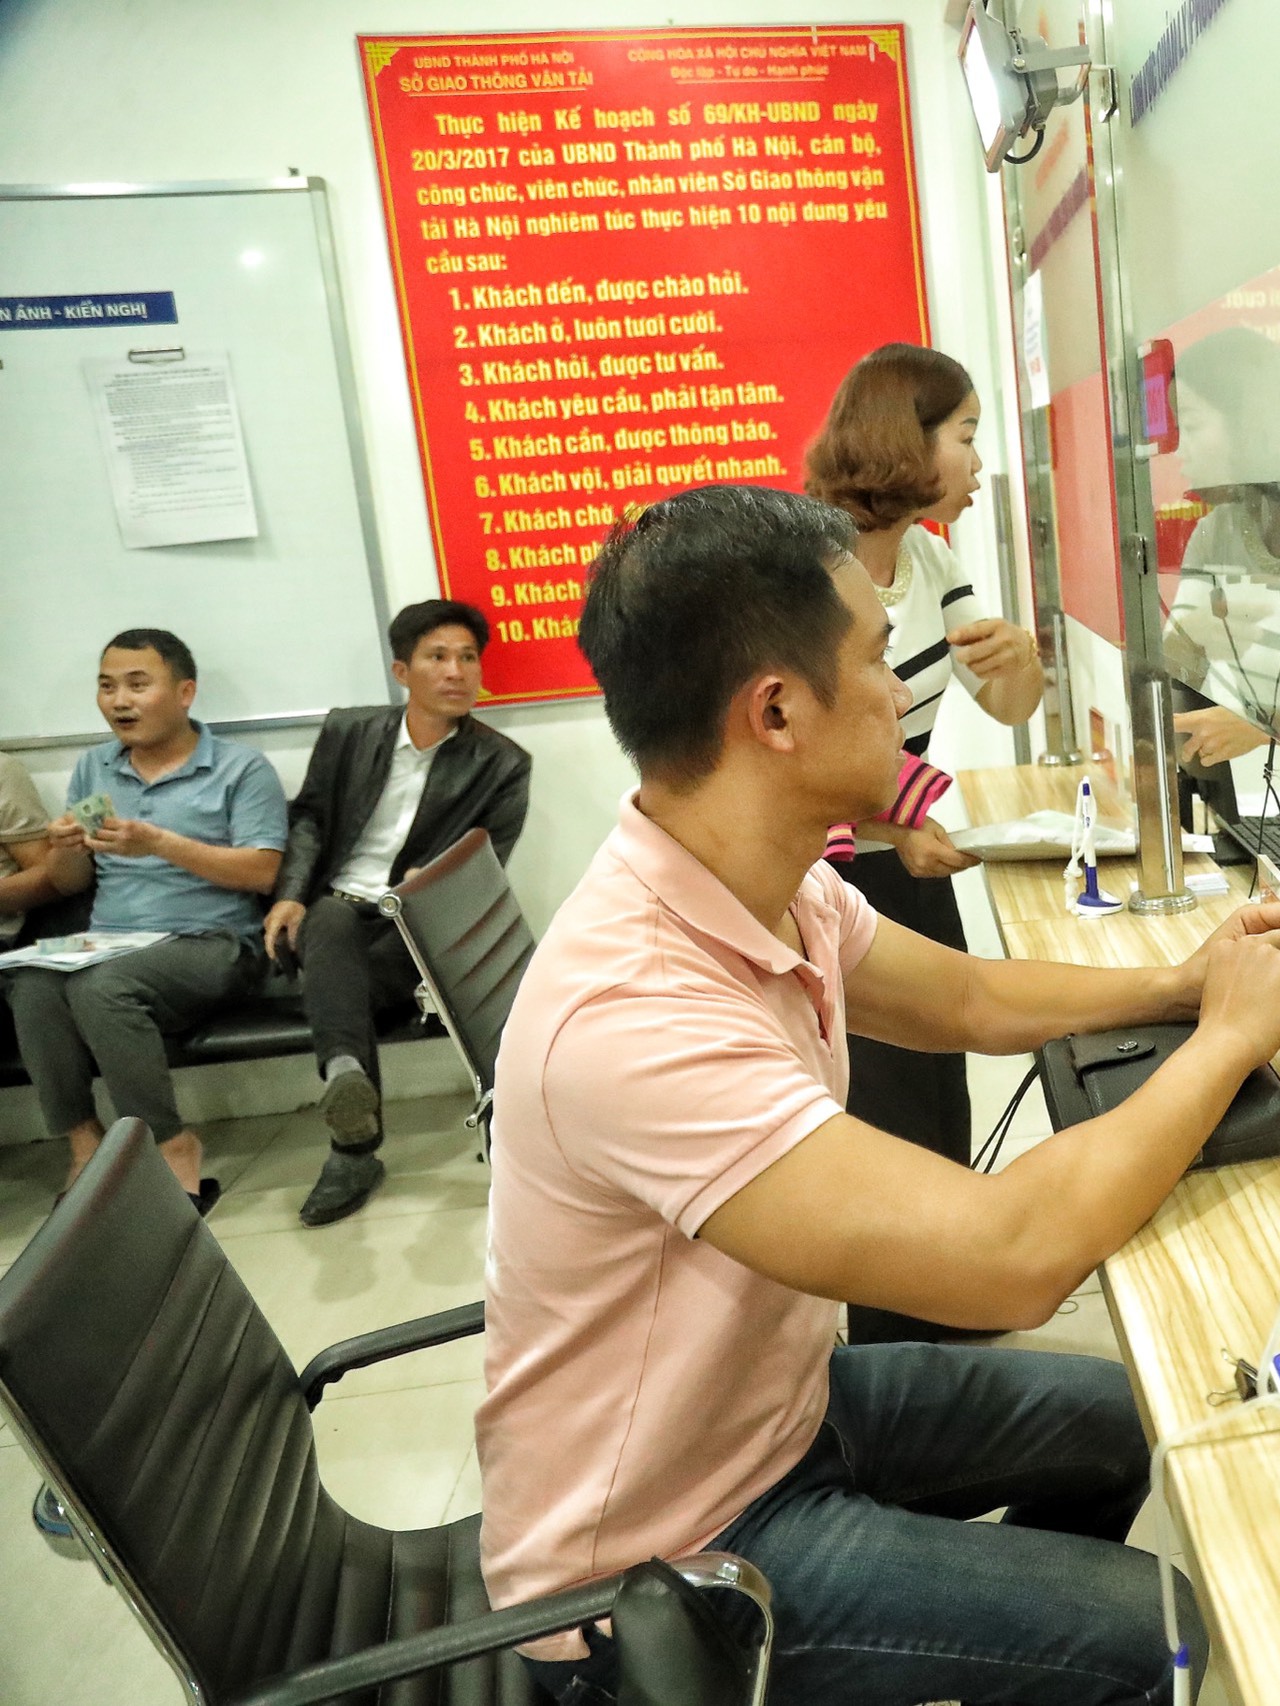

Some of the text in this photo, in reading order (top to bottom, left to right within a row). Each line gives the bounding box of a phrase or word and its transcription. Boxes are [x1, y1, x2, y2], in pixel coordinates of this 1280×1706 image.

[399, 71, 424, 93] SỞ
[427, 75, 468, 92] GIAO
[470, 71, 528, 90] THÔNG
[567, 66, 594, 86] TẢI
[434, 99, 878, 140] Thực hiện Kế hoạch số 69/KH-UBND ngày
[410, 132, 882, 171] 20/3/2017 của UBND Thành phố Hà Nội, cán bộ,
[416, 165, 885, 207] công chức, viên chức, nhân viên Sở Giao thông vận
[420, 198, 888, 241] tải Hà Nội nghiêm túc thực hiện 10 nội dung yêu
[426, 249, 508, 275] cầu sau:
[64, 299, 104, 319] KIẾN
[105, 301, 148, 319] NGHỊ
[448, 269, 749, 311] 1. Khách đến, được chào hỏi.
[453, 309, 723, 349] 2. Khách ở, luôn tươi cười.
[458, 343, 725, 387] 3. Khách hỏi, được tư vấn.
[465, 381, 785, 424] 4. Khách yêu cầu, phải tận tâm.
[469, 418, 778, 461] 5. Khách cần, được thông báo.
[474, 453, 787, 498] 6. Khách vội, giải quyết nhanh.
[478, 511, 502, 535] 7.
[503, 507, 572, 533] Khách
[485, 547, 507, 571] 8.
[508, 543, 576, 570] Khách
[491, 585, 513, 608] 9.
[514, 579, 582, 606] Khách
[496, 619, 531, 644] 10.
